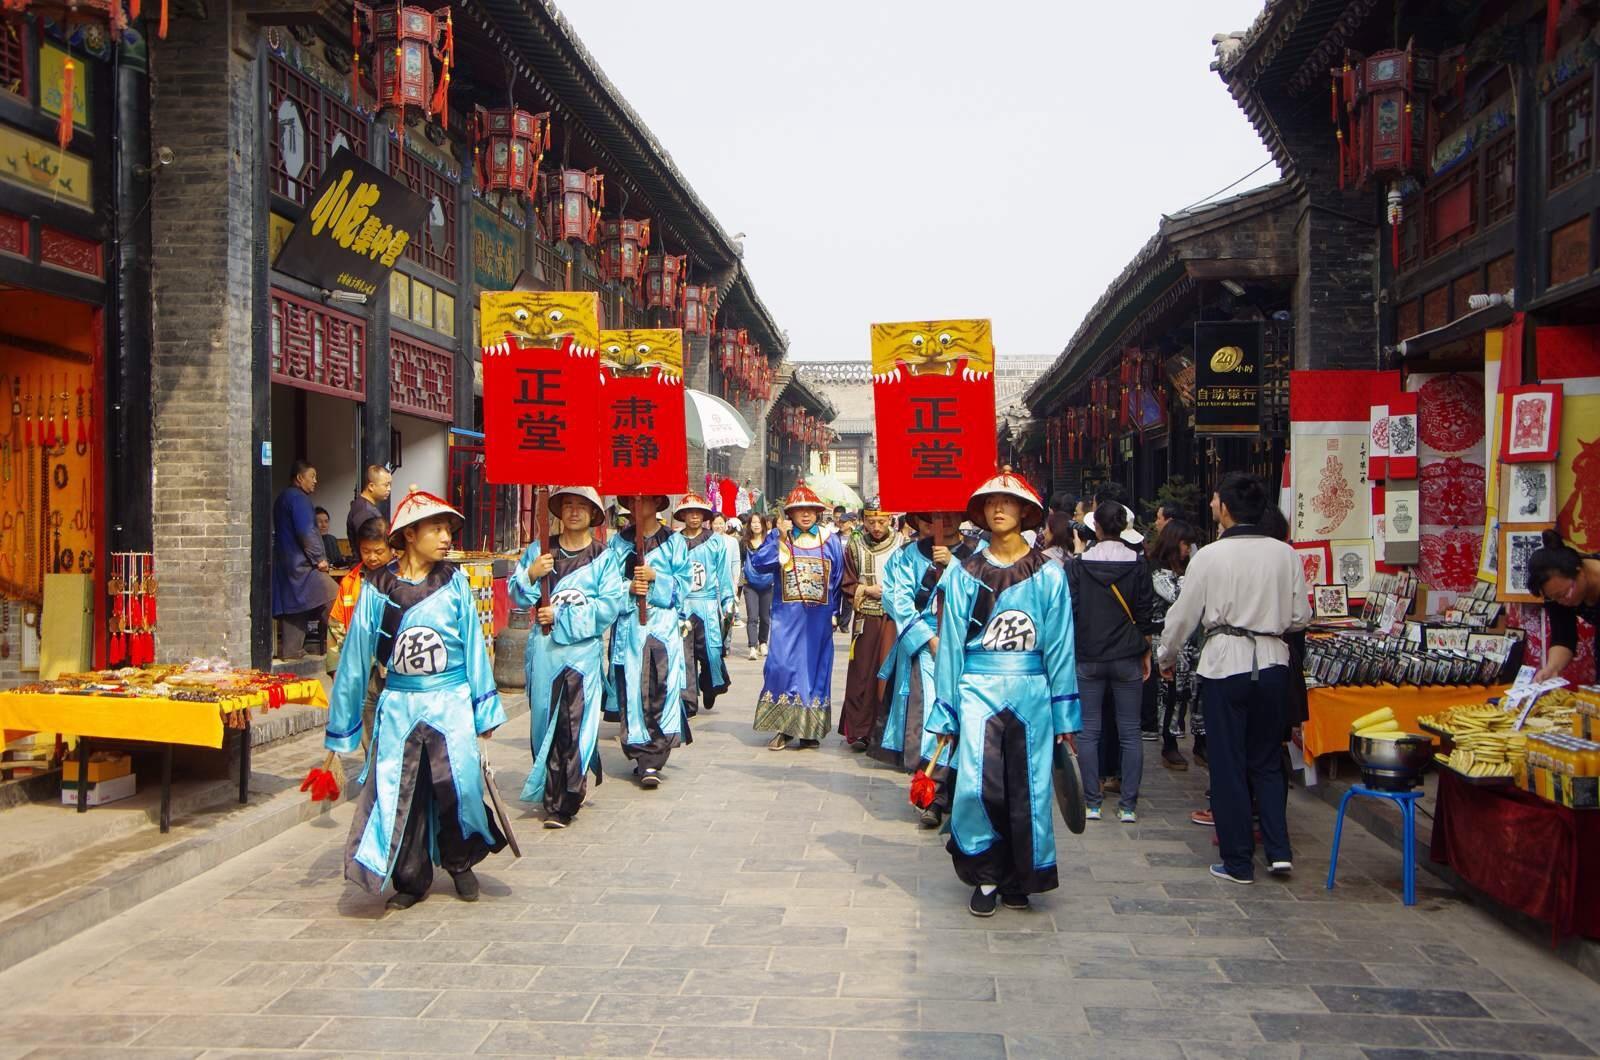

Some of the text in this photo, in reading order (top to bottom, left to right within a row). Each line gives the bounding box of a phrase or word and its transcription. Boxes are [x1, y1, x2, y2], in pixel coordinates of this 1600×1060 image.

[513, 367, 567, 452] 正堂
[610, 394, 659, 468] 肃静
[1197, 387, 1257, 401] 自助银行
[906, 397, 963, 479] 正堂
